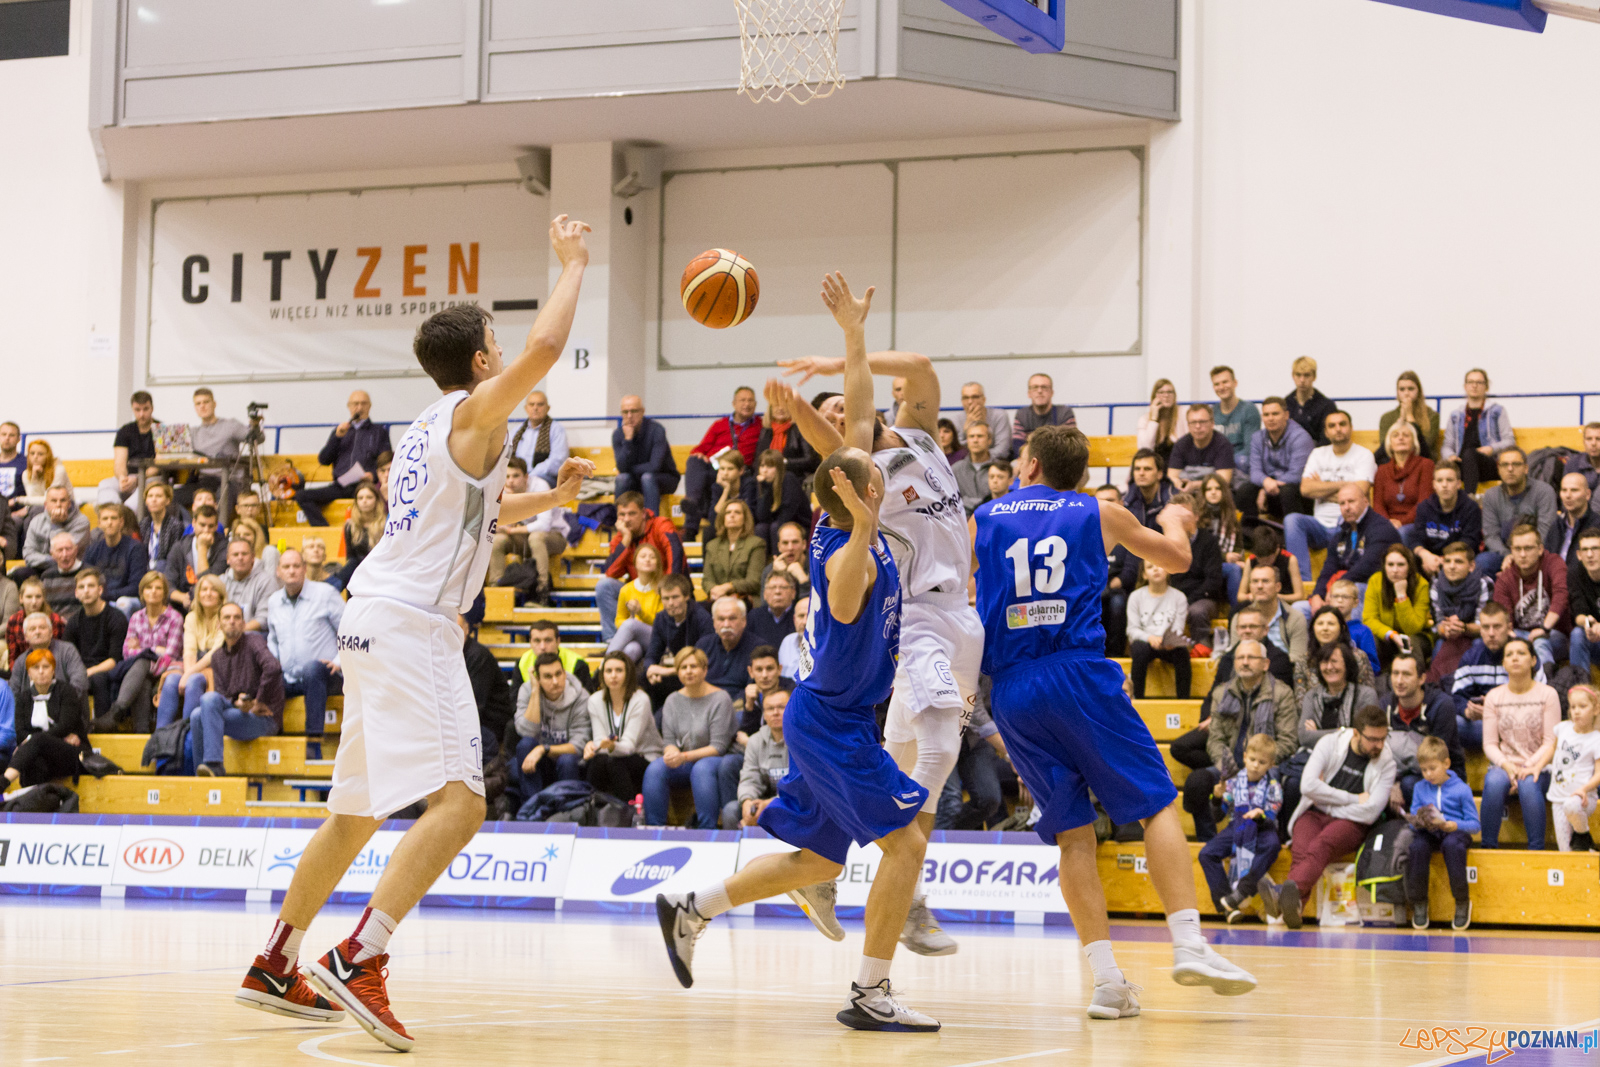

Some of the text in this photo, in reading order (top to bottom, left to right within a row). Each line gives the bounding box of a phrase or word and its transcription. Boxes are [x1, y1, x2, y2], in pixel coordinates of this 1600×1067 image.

[181, 242, 480, 304] CITYZEN
[269, 305, 318, 321] WIĘCEJ
[356, 303, 393, 317] KLUB
[574, 348, 590, 370] B
[989, 498, 1067, 516] Polfarmex
[1005, 535, 1068, 598] 13
[1168, 716, 1180, 726] 15
[149, 791, 159, 801] 10
[212, 791, 218, 801] 9
[17, 842, 109, 867] NICKEL
[133, 846, 173, 865] KIA
[198, 847, 257, 868] DELIK
[448, 852, 548, 882] OZnan
[624, 861, 676, 880] atrem
[1552, 871, 1560, 883] 9
[926, 888, 957, 896] POLSKI
[961, 889, 1016, 898] PRODUCENT
